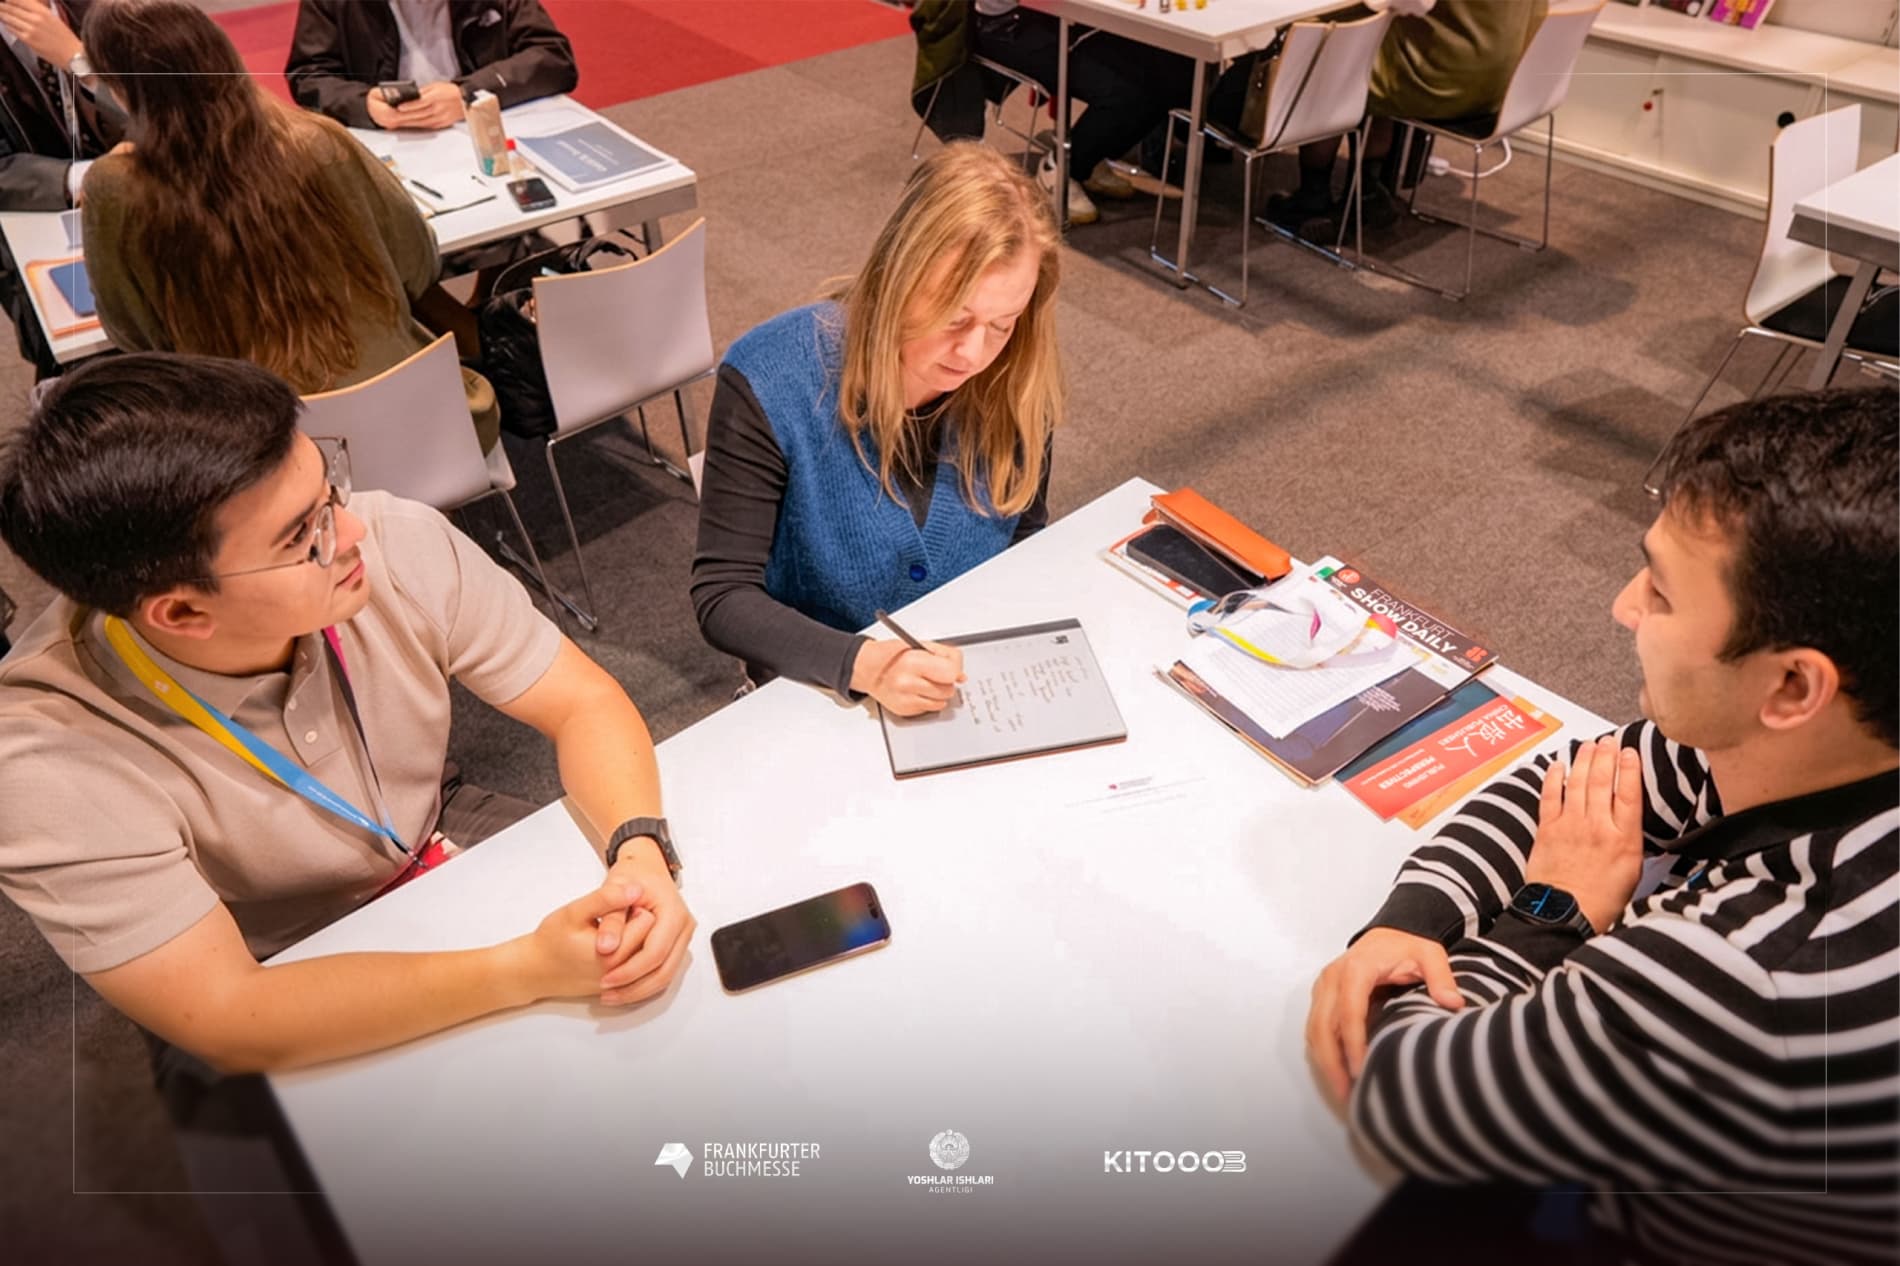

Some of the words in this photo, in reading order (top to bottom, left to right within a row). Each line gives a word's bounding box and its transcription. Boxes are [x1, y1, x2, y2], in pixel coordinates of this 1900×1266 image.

[1350, 587, 1406, 622] SHOW
[1401, 620, 1457, 653] DAILY
[1370, 588, 1455, 639] FRANKFURT
